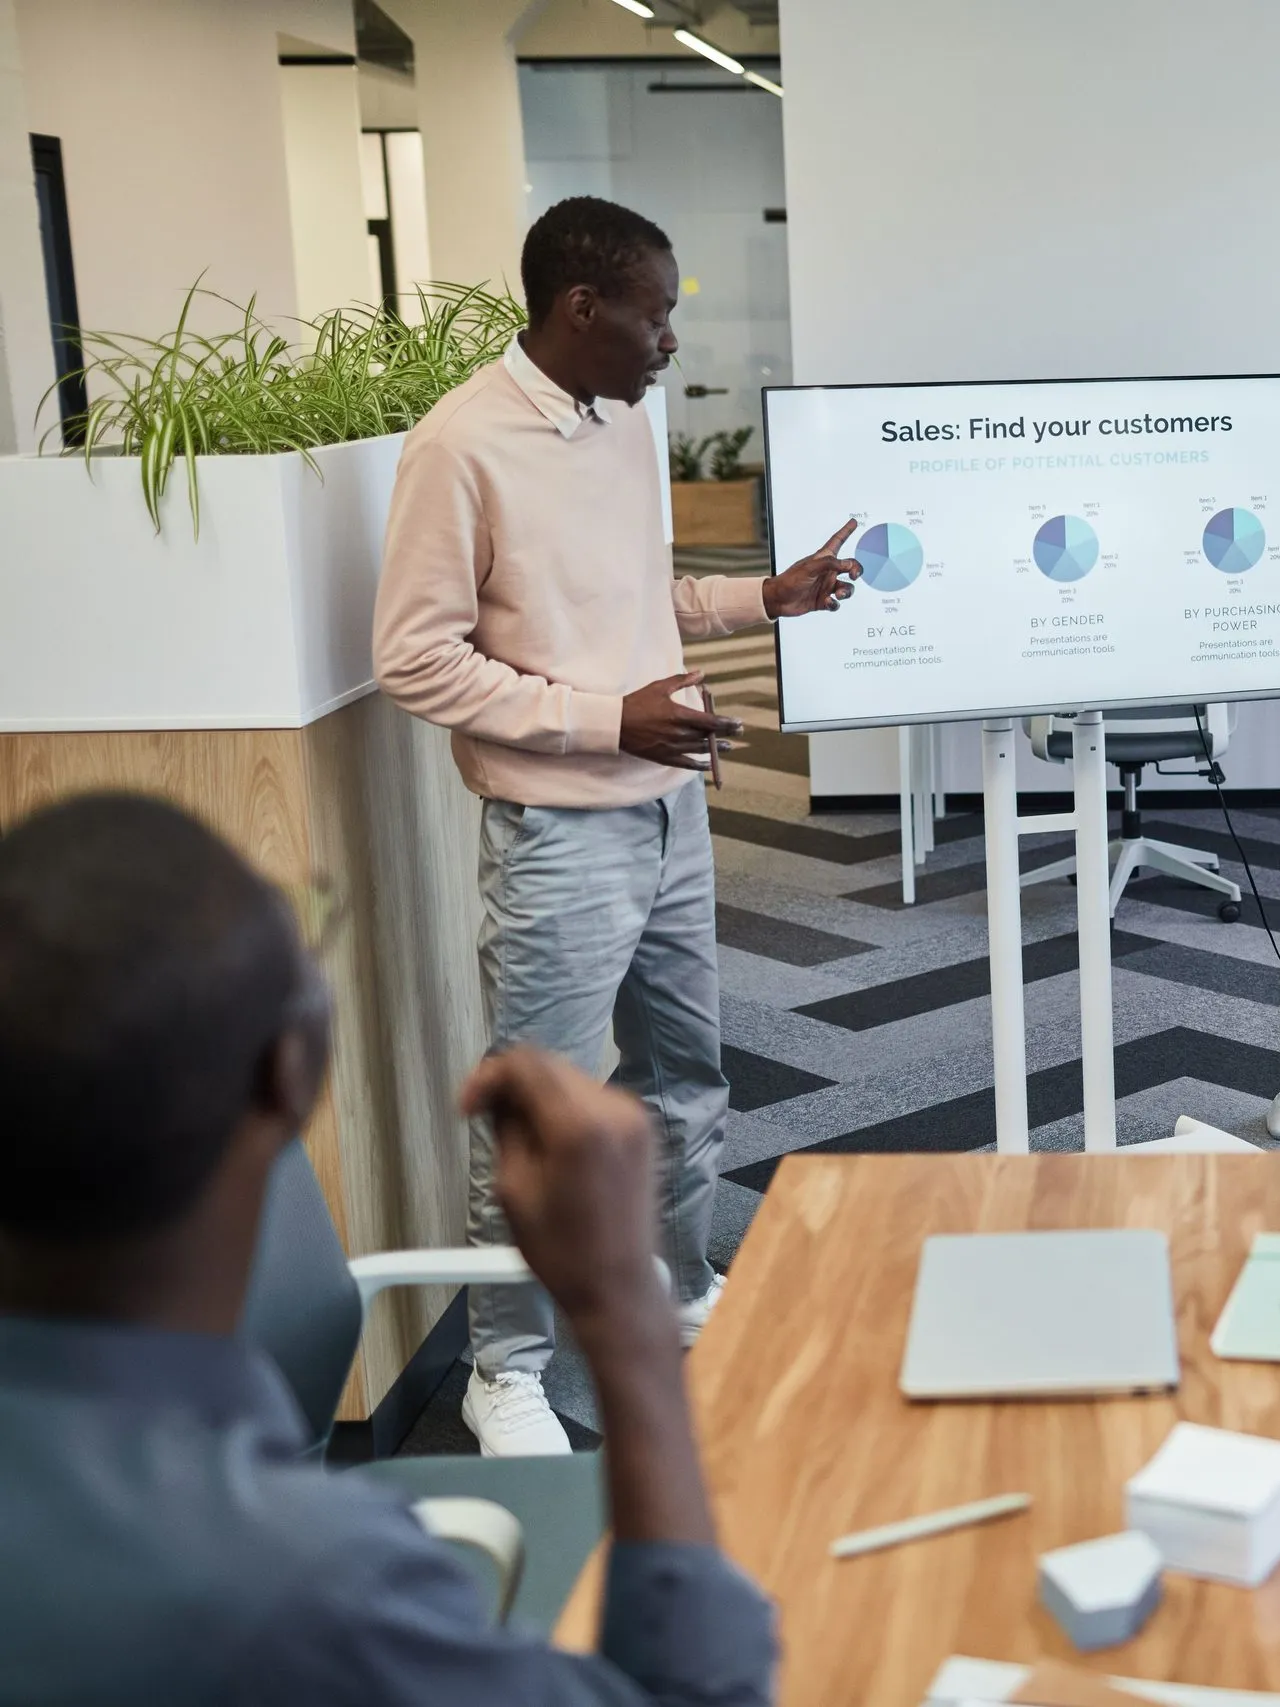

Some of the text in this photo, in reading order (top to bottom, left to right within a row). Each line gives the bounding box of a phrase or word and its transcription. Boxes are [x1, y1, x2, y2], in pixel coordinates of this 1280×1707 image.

[881, 412, 1233, 443] Sales: Find your customers
[909, 450, 1210, 474] PROFILE OF POTENTIAL CUSTOMERS
[1184, 609, 1200, 619] BY
[1031, 614, 1104, 628] BY GENDER
[1213, 620, 1257, 632] POWER
[867, 626, 916, 638] BY AGE
[1030, 635, 1091, 645] Presentations
[1199, 640, 1257, 649] Presentations
[853, 646, 916, 656] Presentations
[1022, 646, 1090, 658] communication
[1191, 651, 1256, 662] communication
[844, 659, 916, 669] communication
